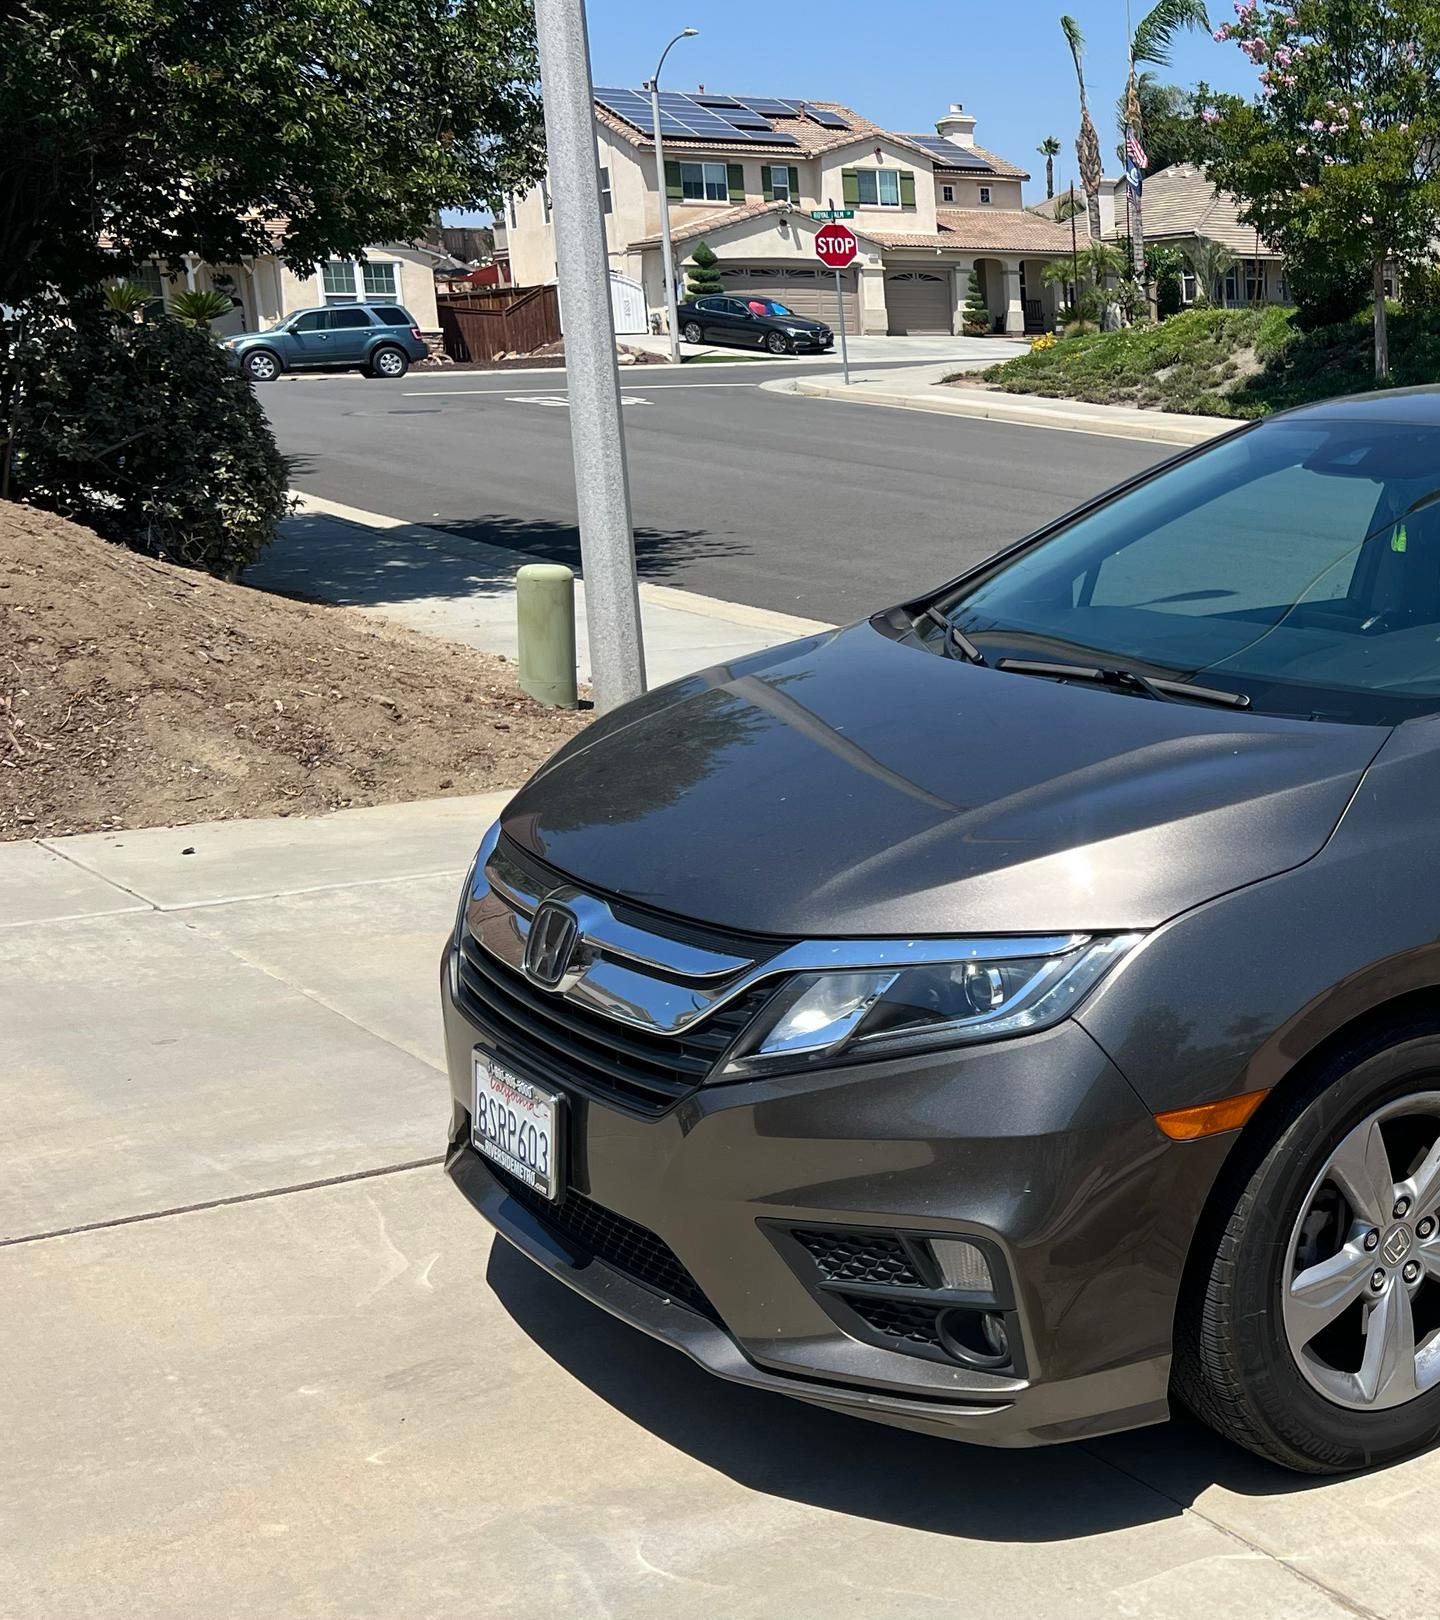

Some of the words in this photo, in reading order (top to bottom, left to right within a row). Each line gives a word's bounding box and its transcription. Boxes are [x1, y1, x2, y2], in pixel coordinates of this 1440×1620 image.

[813, 211, 830, 219] ROYAL
[817, 237, 855, 255] STOP
[478, 1091, 548, 1175] 8SRP603
